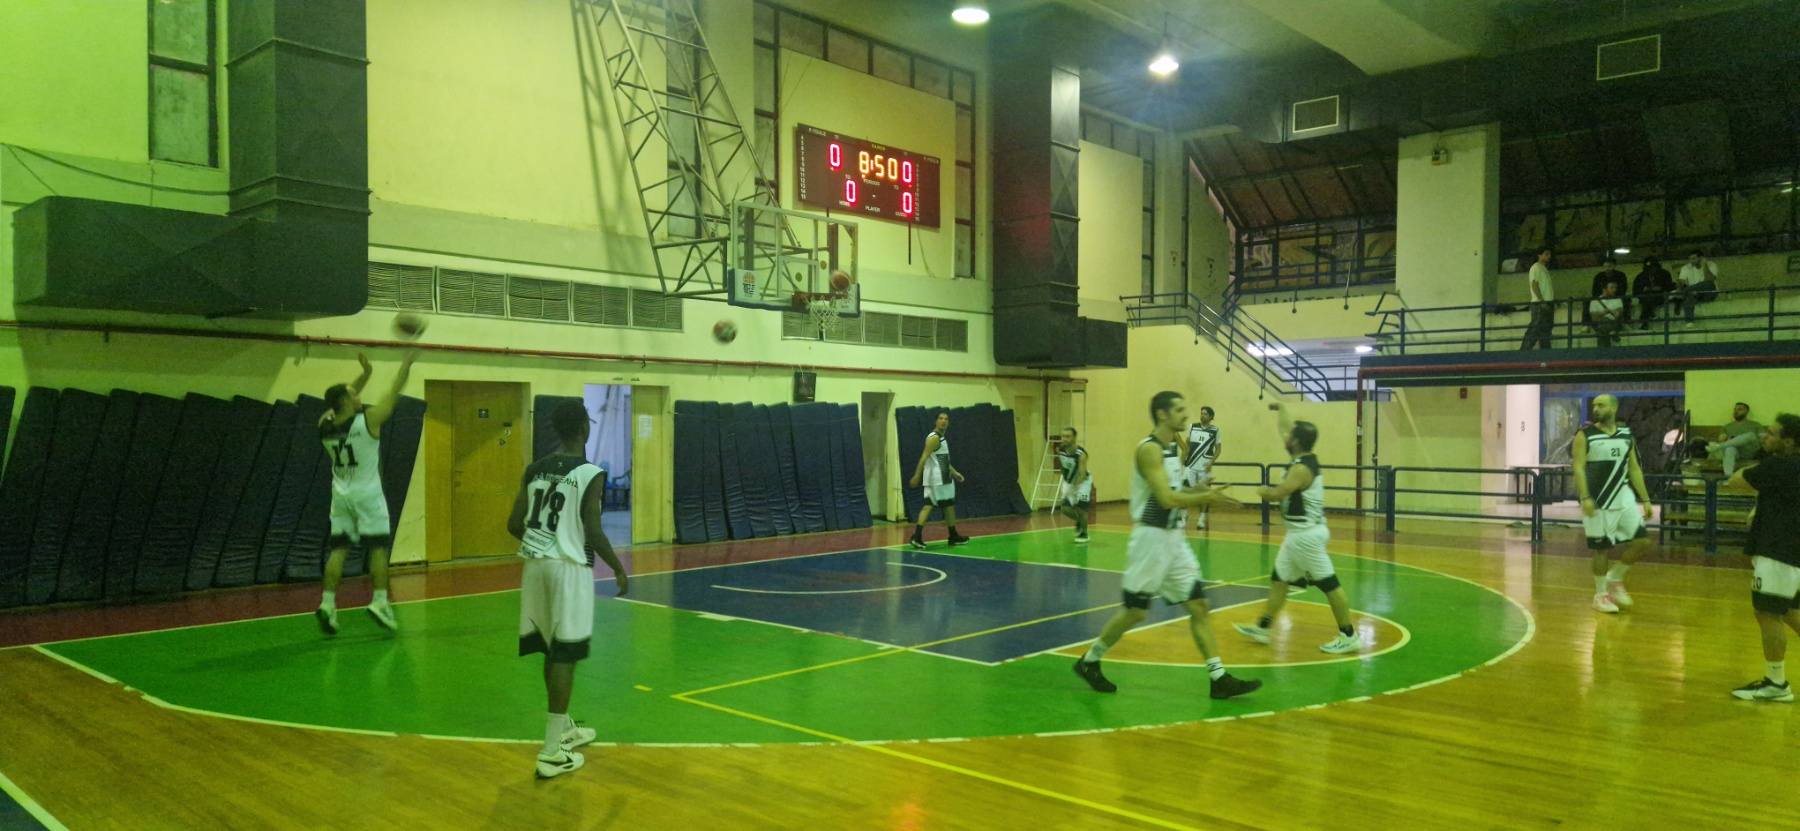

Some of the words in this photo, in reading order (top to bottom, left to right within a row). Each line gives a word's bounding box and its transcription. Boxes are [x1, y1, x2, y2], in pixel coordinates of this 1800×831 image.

[829, 143, 841, 167] 0
[859, 150, 898, 180] 8:50
[902, 161, 912, 183] 0
[846, 180, 856, 203] 0
[902, 192, 912, 214] 0
[332, 443, 358, 468] 11
[1610, 447, 1621, 457] 21
[527, 488, 566, 532] 18
